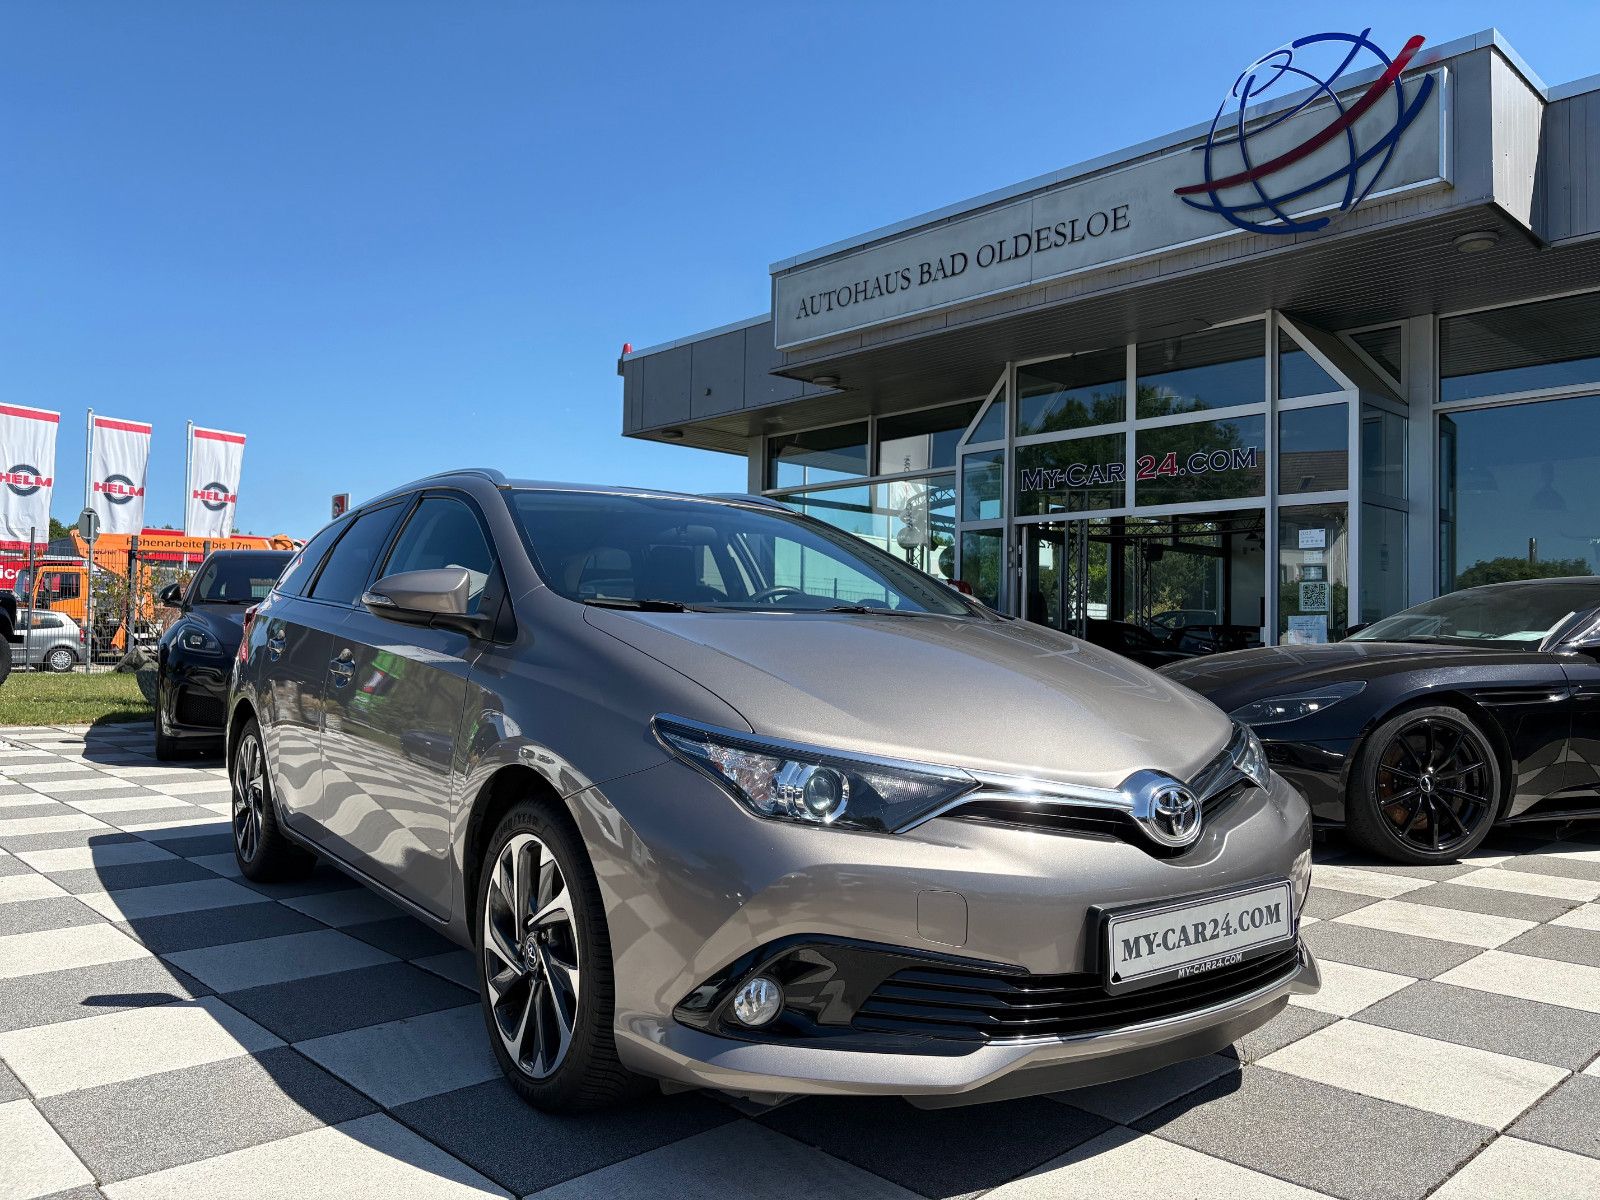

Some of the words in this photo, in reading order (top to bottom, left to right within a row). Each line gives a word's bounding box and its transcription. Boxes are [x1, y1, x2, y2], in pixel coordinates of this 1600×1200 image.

[795, 267, 912, 320] AUTOHAUS
[918, 251, 969, 286] BAD
[976, 203, 1131, 268] OLDESLOE
[0, 472, 53, 487] HELM
[93, 481, 145, 497] HELM
[192, 489, 237, 504] HELM
[212, 540, 227, 550] bis
[231, 541, 252, 550] 17m
[1121, 902, 1282, 962] MY-CAR24.COM
[1177, 952, 1243, 979] MY-CAR24.COM
